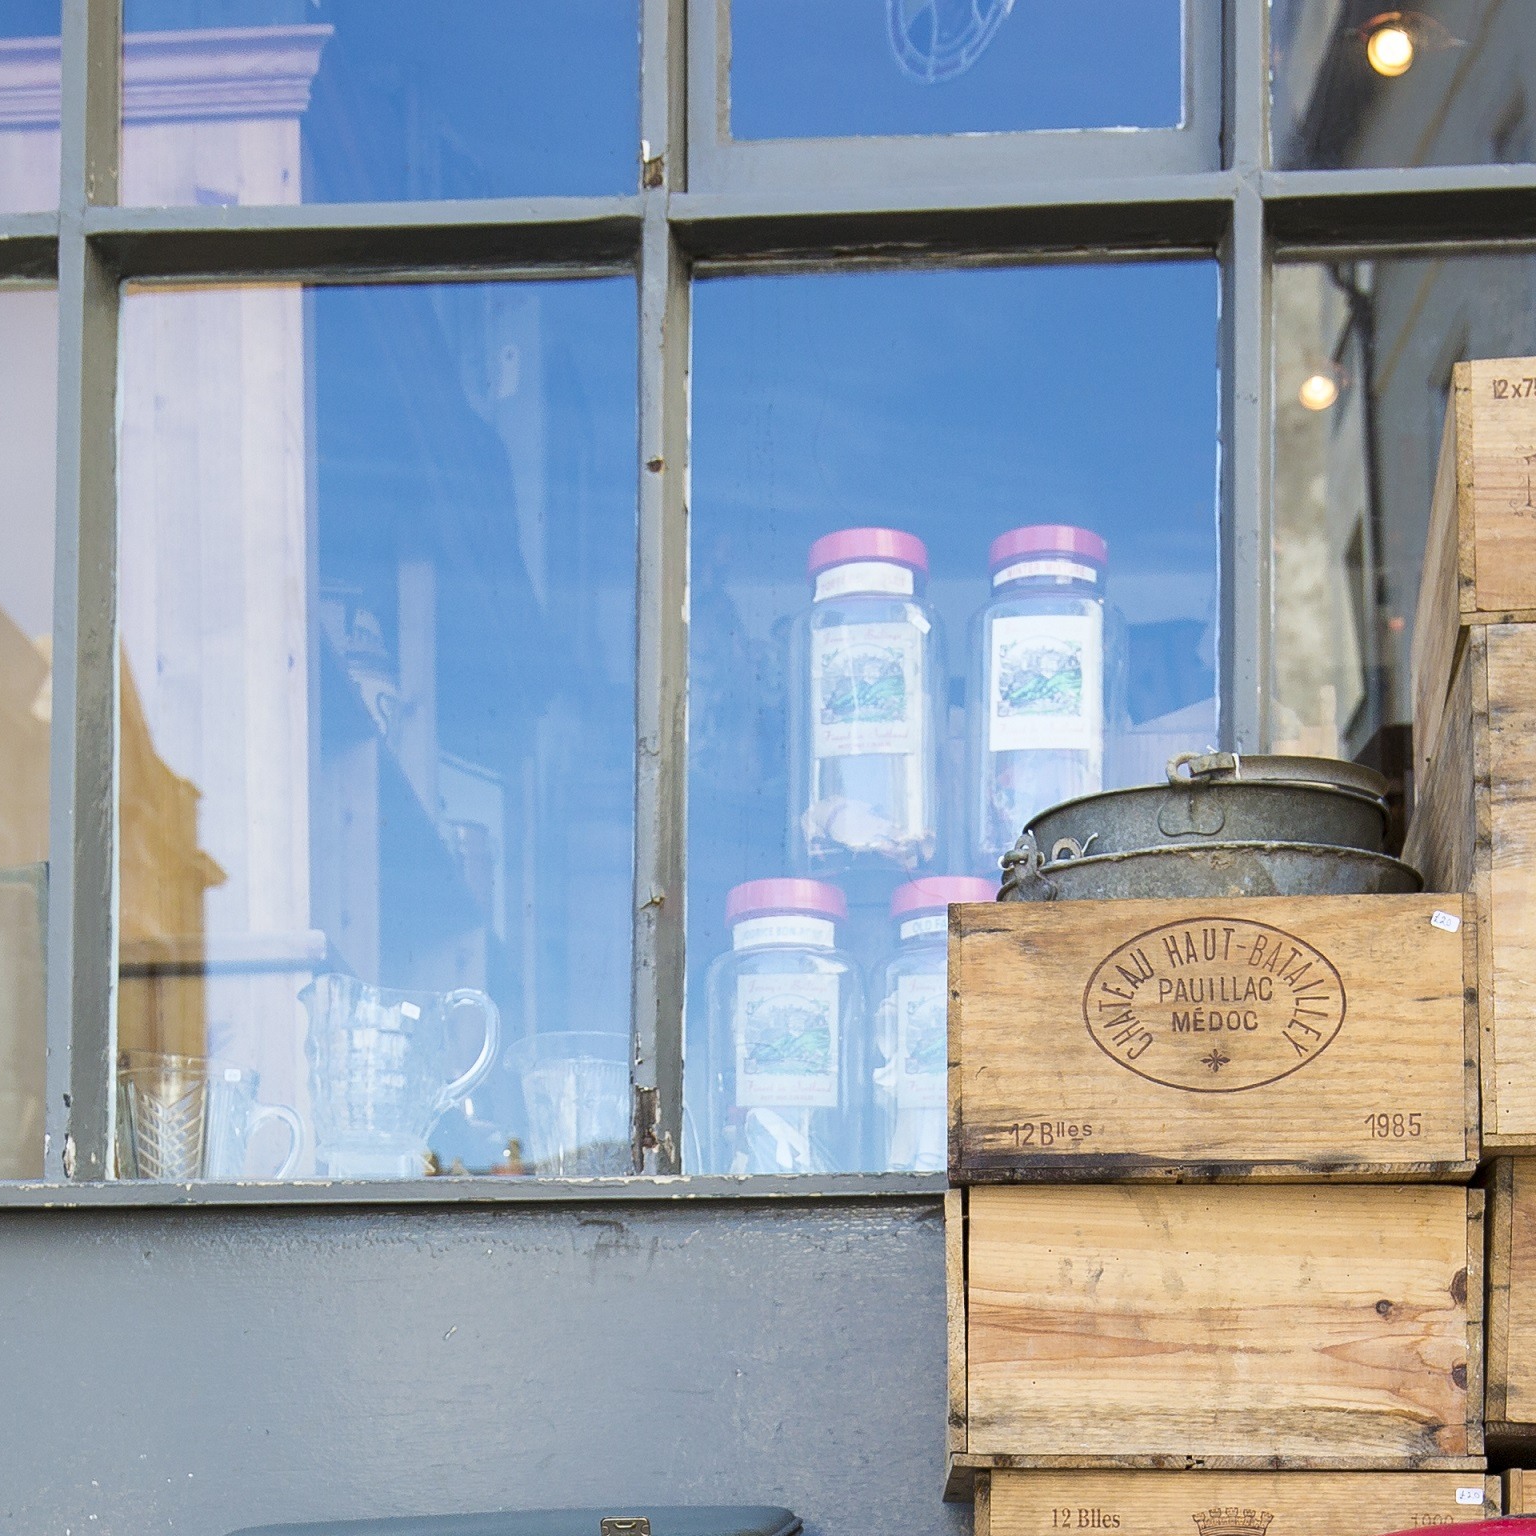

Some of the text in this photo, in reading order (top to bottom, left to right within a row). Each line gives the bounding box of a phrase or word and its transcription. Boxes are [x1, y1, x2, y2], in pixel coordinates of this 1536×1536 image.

[1158, 976, 1274, 1004] PAUILLAC
[1171, 1006, 1259, 1032] MÉDOC
[1363, 1111, 1422, 1138] 1985
[1051, 1508, 1071, 1528] 12
